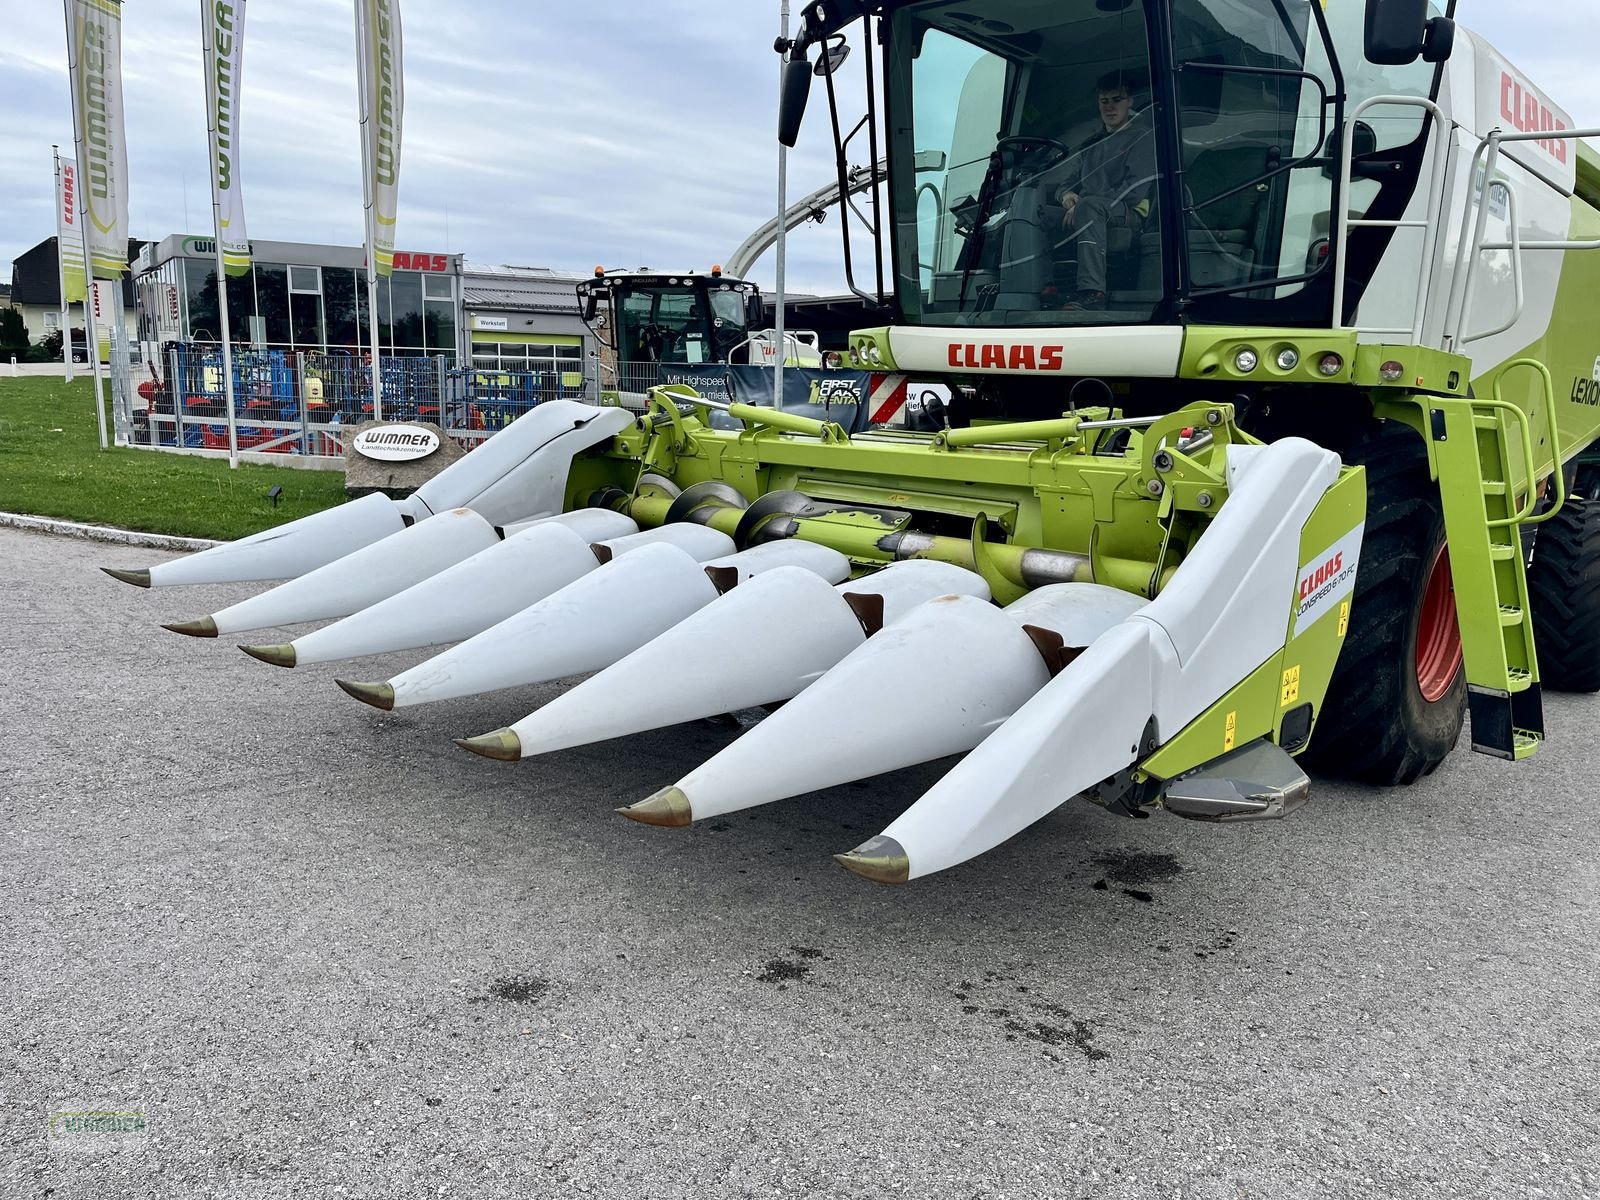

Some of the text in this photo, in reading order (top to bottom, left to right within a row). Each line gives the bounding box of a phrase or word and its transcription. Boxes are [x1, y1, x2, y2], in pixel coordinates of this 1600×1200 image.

[84, 20, 107, 199] WIMMER
[215, 0, 233, 190] WIMMER
[1500, 70, 1567, 165] CLAAS
[64, 163, 74, 225] CLAAS
[948, 343, 1064, 371] CLAAS
[667, 374, 681, 385] Mit
[820, 379, 857, 389] FIRST
[361, 444, 427, 454] Landtechnikzentrum
[364, 432, 431, 447] WIMMER
[1299, 550, 1343, 601] CLAAS
[1297, 582, 1332, 617] CONSPEED
